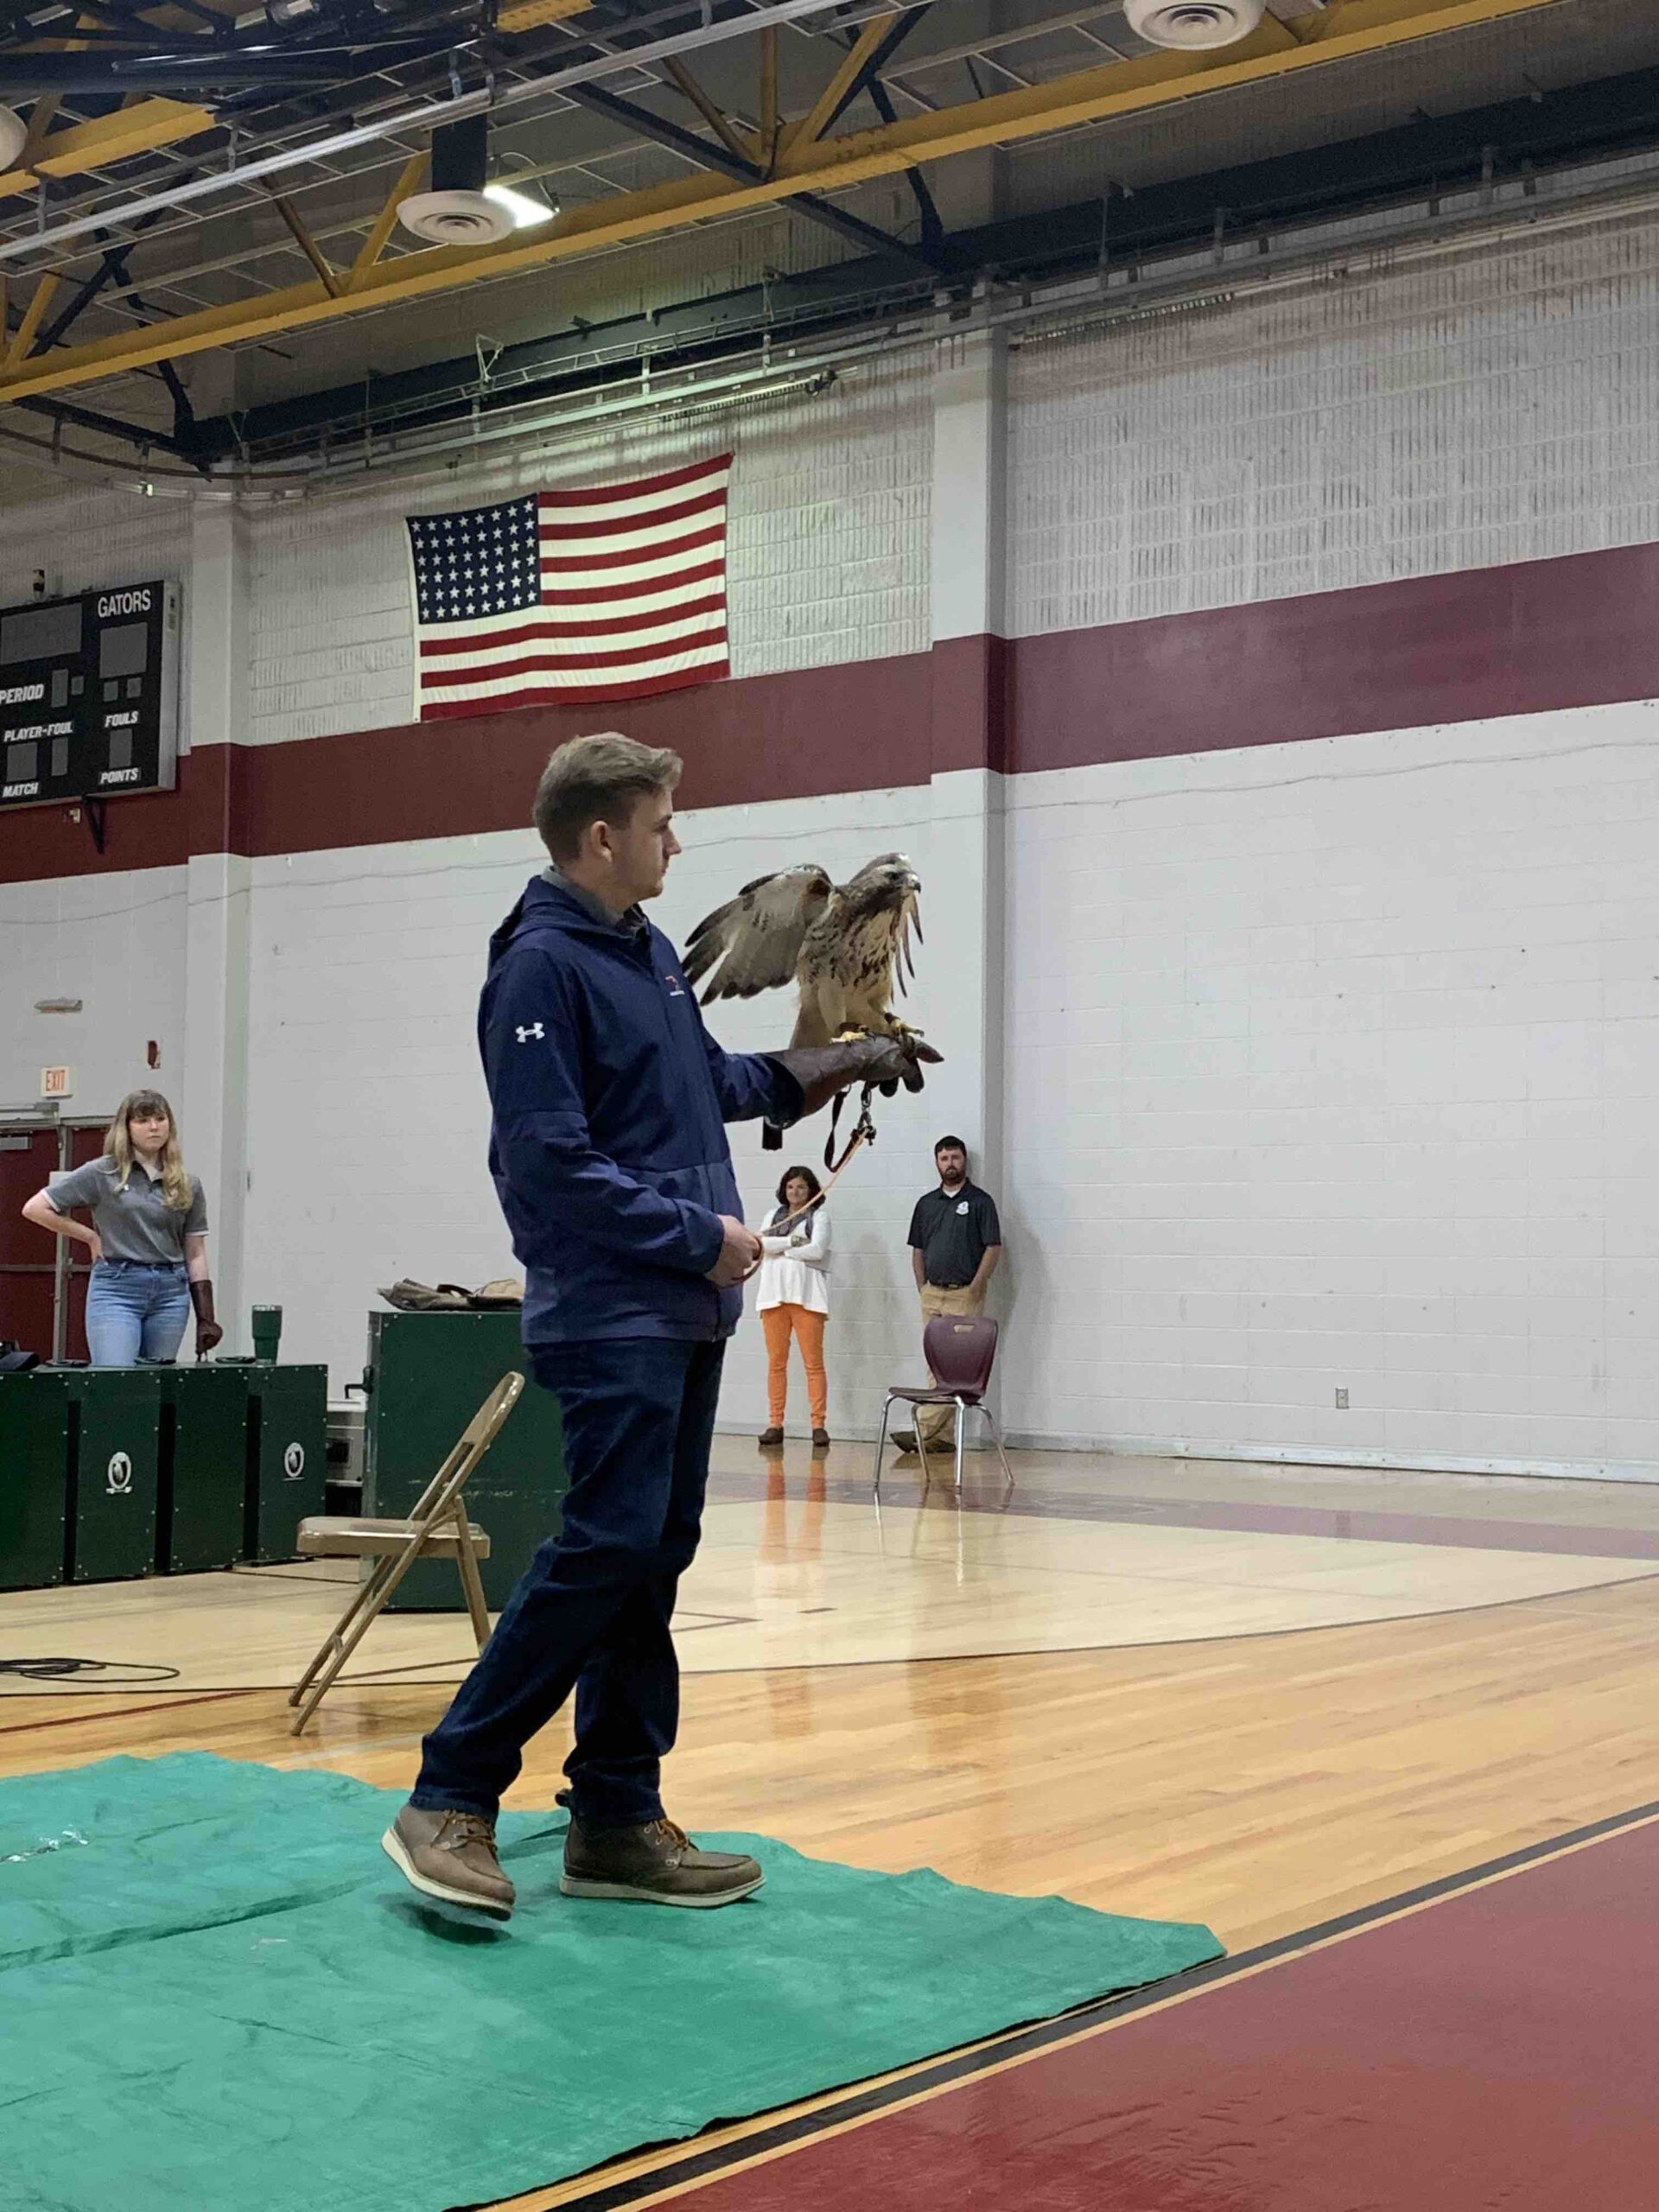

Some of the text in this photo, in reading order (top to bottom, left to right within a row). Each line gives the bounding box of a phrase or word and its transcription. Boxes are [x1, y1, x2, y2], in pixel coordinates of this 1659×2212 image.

[98, 589, 151, 617] GATORS
[0, 683, 44, 704] PERIOD
[105, 710, 138, 728] FOULS
[3, 721, 73, 741] PLAYER-FOUL
[100, 767, 138, 785] POINTS
[3, 781, 38, 798] MATCH
[46, 1070, 65, 1091] EXIT
